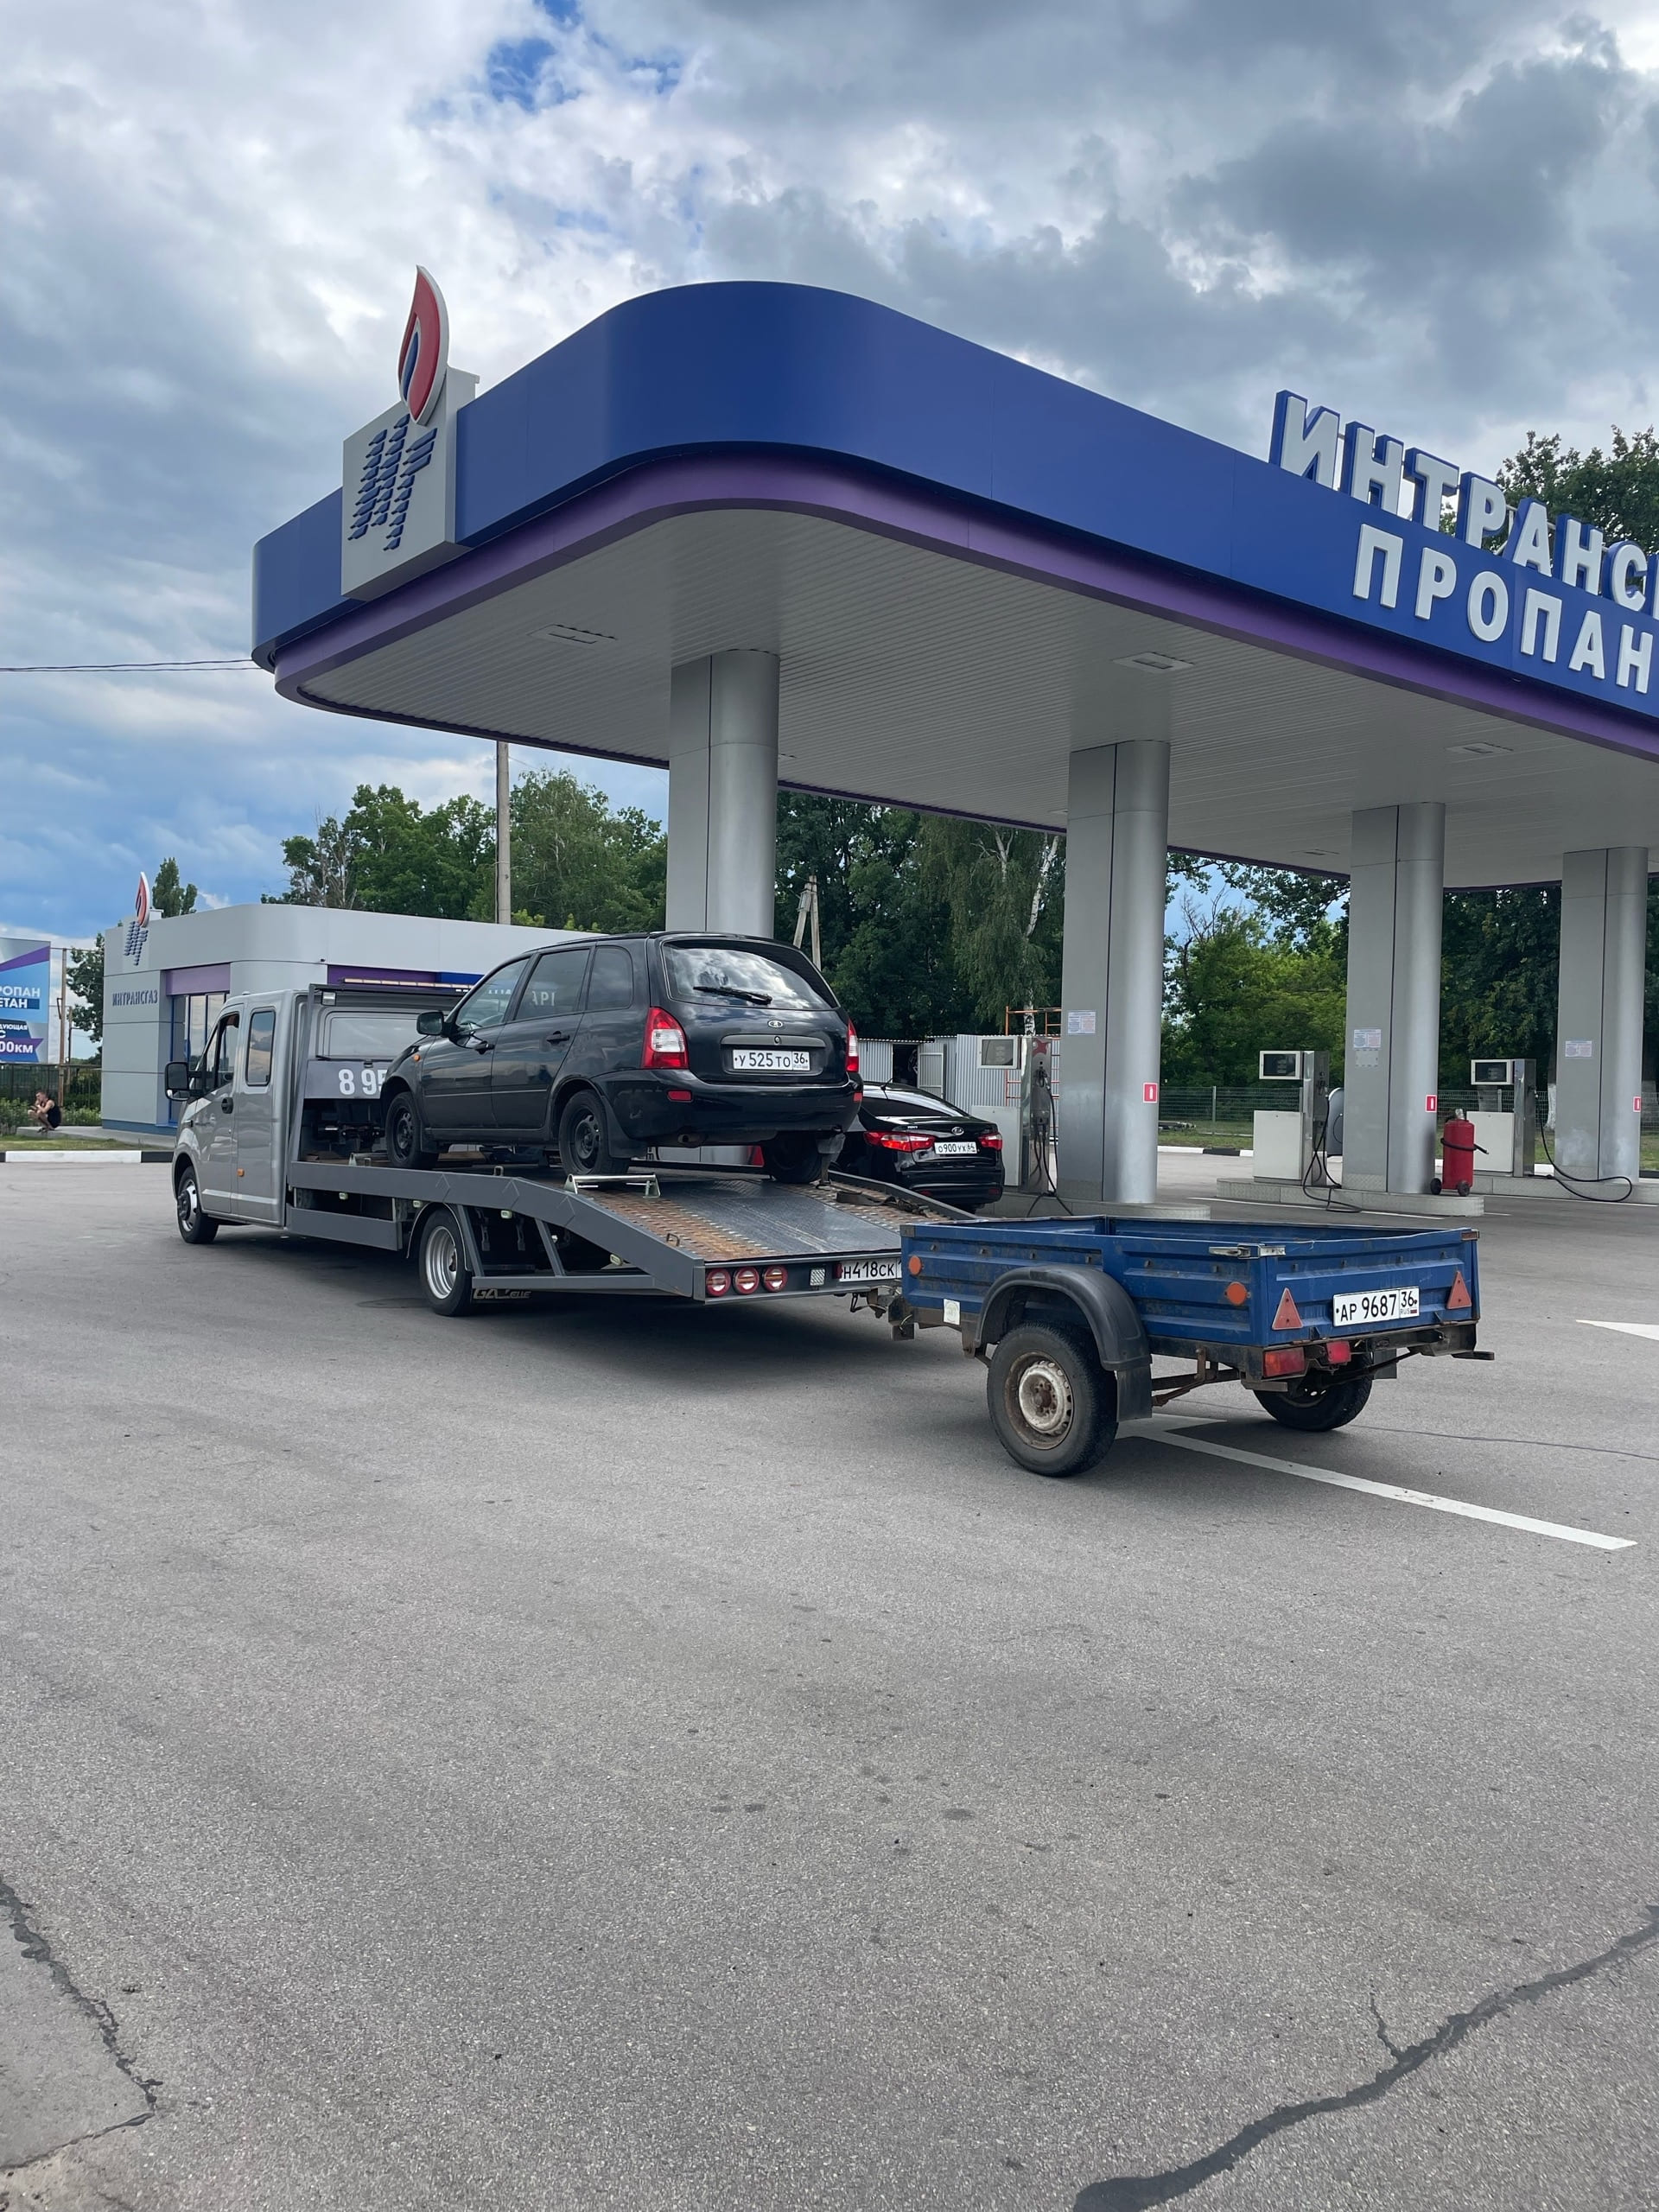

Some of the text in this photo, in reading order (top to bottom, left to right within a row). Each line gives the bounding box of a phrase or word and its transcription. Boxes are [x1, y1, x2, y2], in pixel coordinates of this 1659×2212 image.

[1269, 390, 1659, 620] ИНТРАНС
[1352, 524, 1653, 694] ПРОПАН
[0, 985, 41, 998] ОПАН
[112, 989, 158, 1006] ИНТРАНСГАЗ
[338, 1068, 355, 1096] 8
